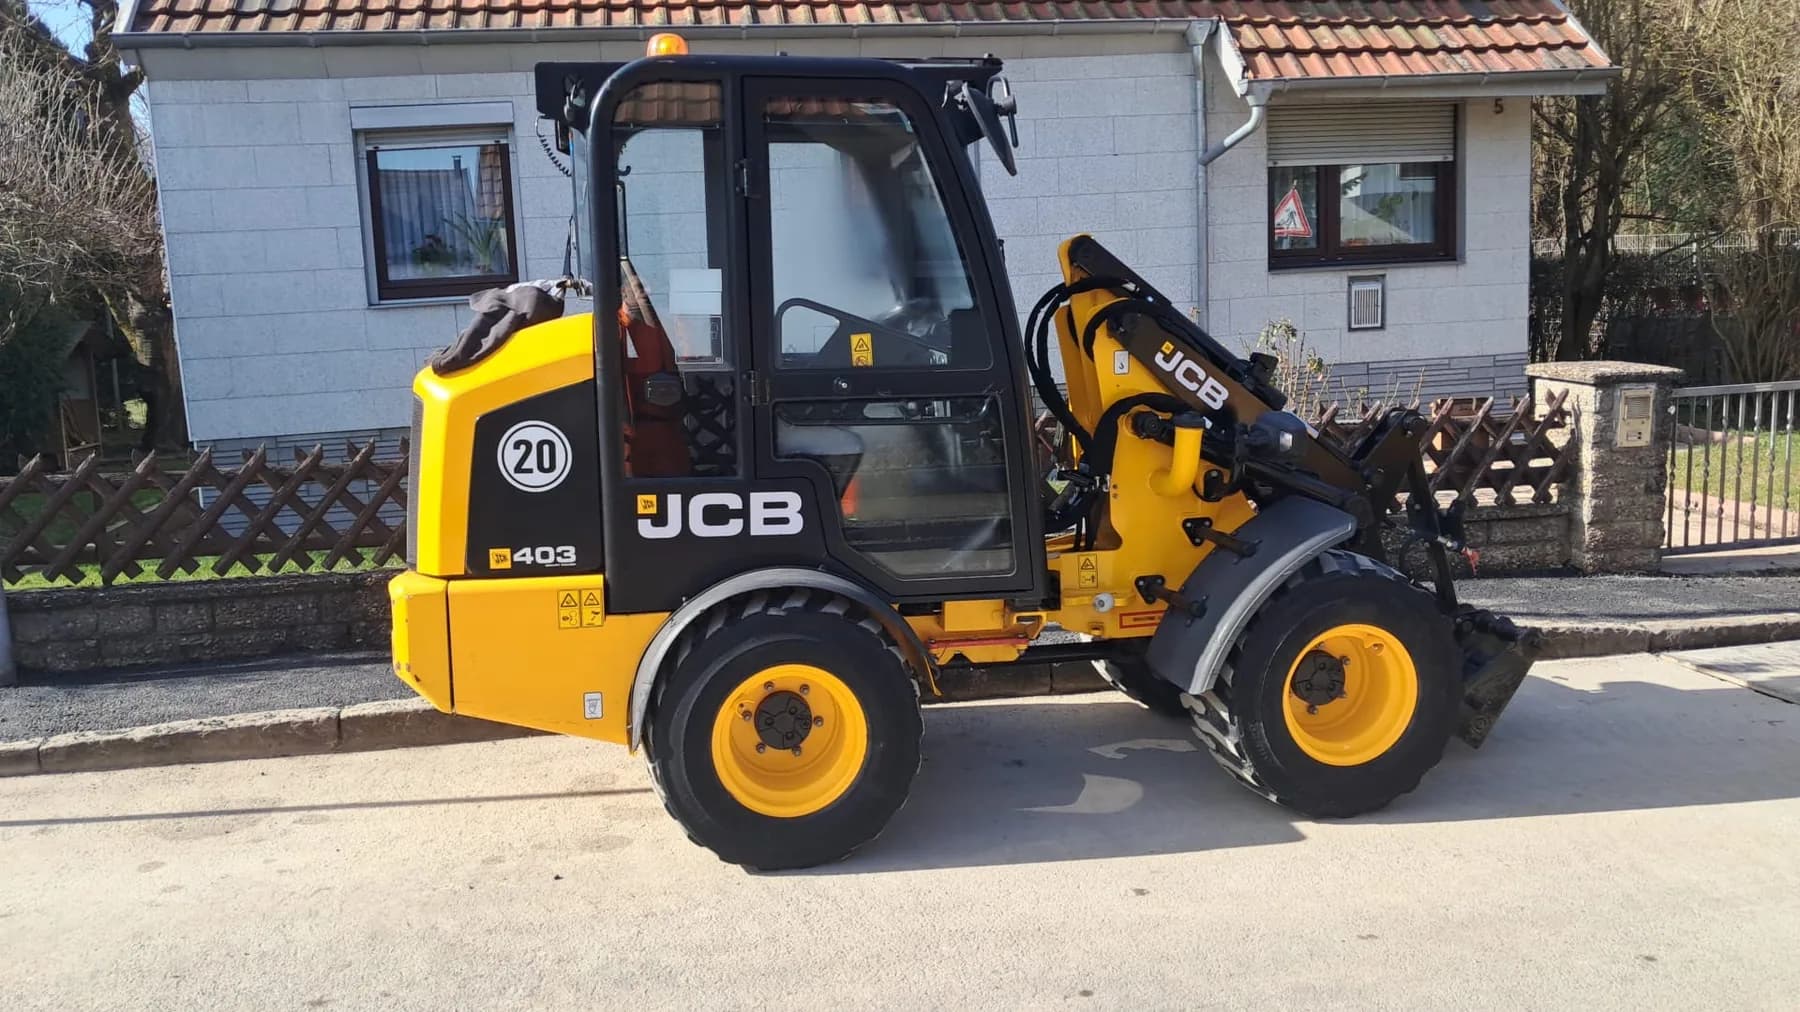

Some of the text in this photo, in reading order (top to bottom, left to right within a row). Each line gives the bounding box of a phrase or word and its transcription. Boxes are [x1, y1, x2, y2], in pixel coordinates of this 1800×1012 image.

[1493, 98, 1504, 114] 5
[1154, 351, 1229, 410] JCB
[513, 439, 556, 473] 20
[637, 492, 804, 539] JCB
[513, 545, 577, 564] 403
